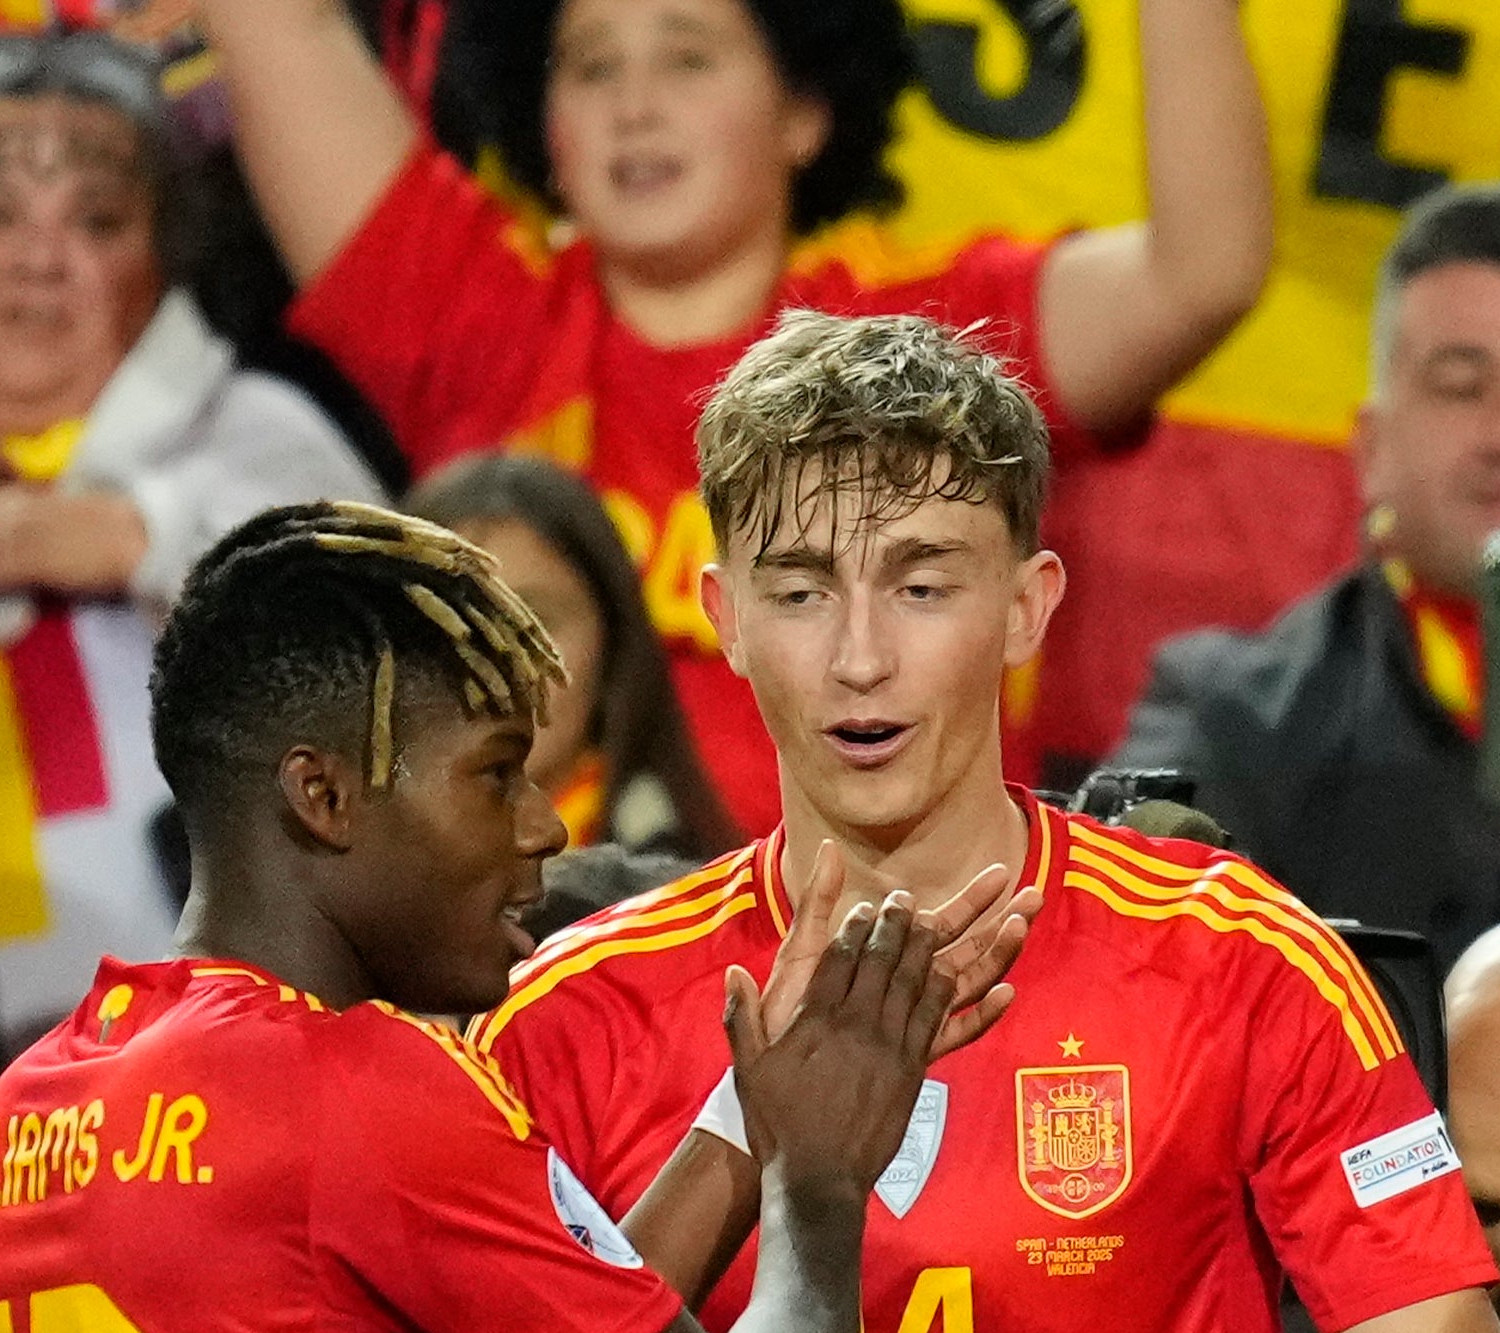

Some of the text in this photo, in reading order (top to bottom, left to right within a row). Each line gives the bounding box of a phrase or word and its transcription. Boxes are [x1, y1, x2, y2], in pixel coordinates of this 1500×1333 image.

[112, 1092, 214, 1184] JR.
[1352, 1139, 1443, 1186] FOUNDATION
[1015, 1238, 1047, 1252] SPAIN
[1056, 1235, 1124, 1250] NETHERLANDS
[1027, 1248, 1113, 1265] 23 MARCH 2025
[1046, 1262, 1096, 1277] VALENCIA
